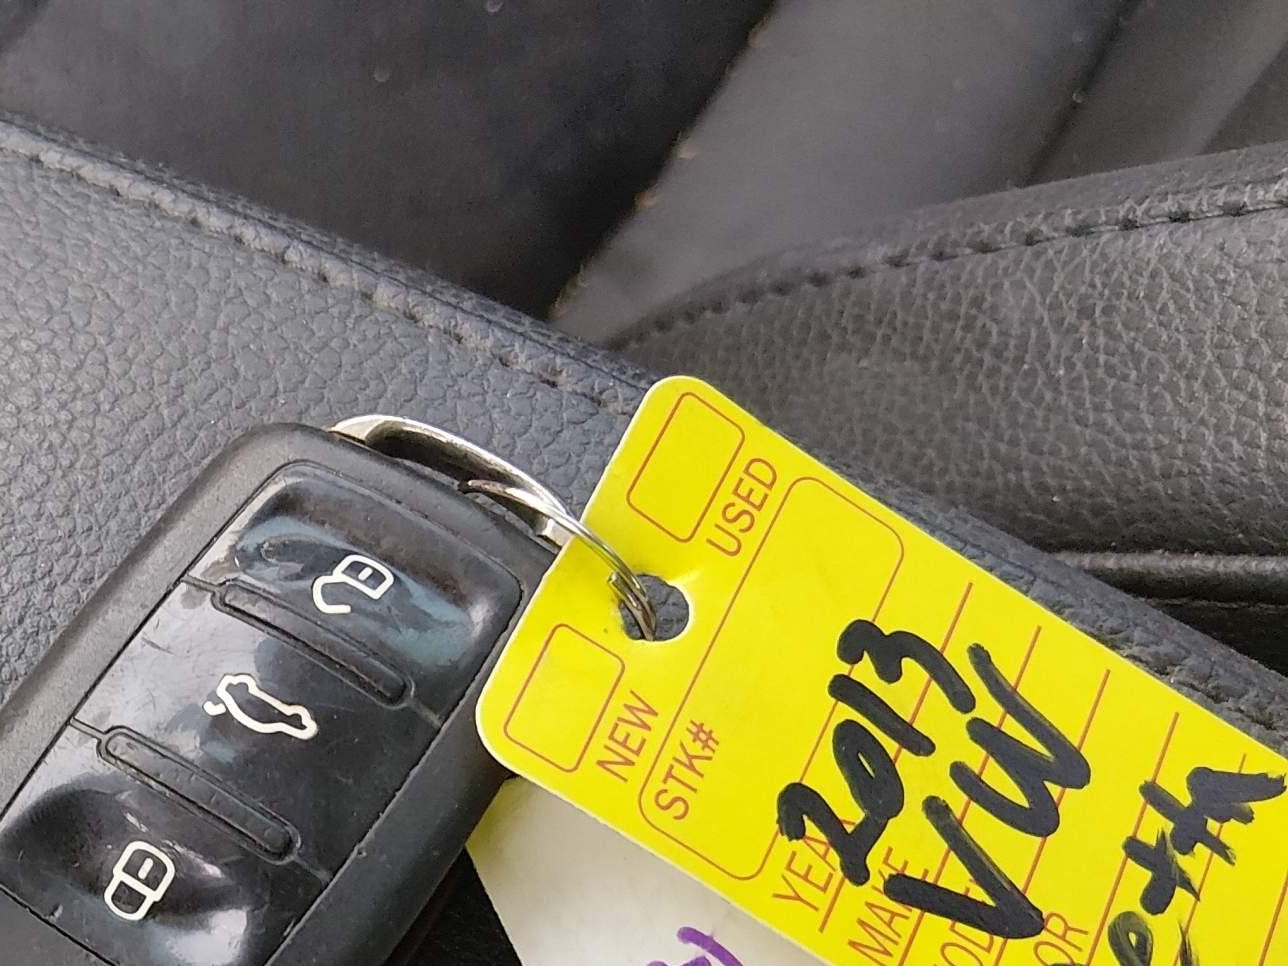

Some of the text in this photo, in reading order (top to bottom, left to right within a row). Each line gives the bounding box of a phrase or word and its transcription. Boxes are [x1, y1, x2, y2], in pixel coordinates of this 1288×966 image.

[705, 457, 778, 557] USED
[595, 689, 659, 782] NEW
[653, 719, 720, 821] STK#
[777, 618, 976, 887] 2013
[883, 643, 1091, 940] VW
[772, 818, 858, 912] YEA
